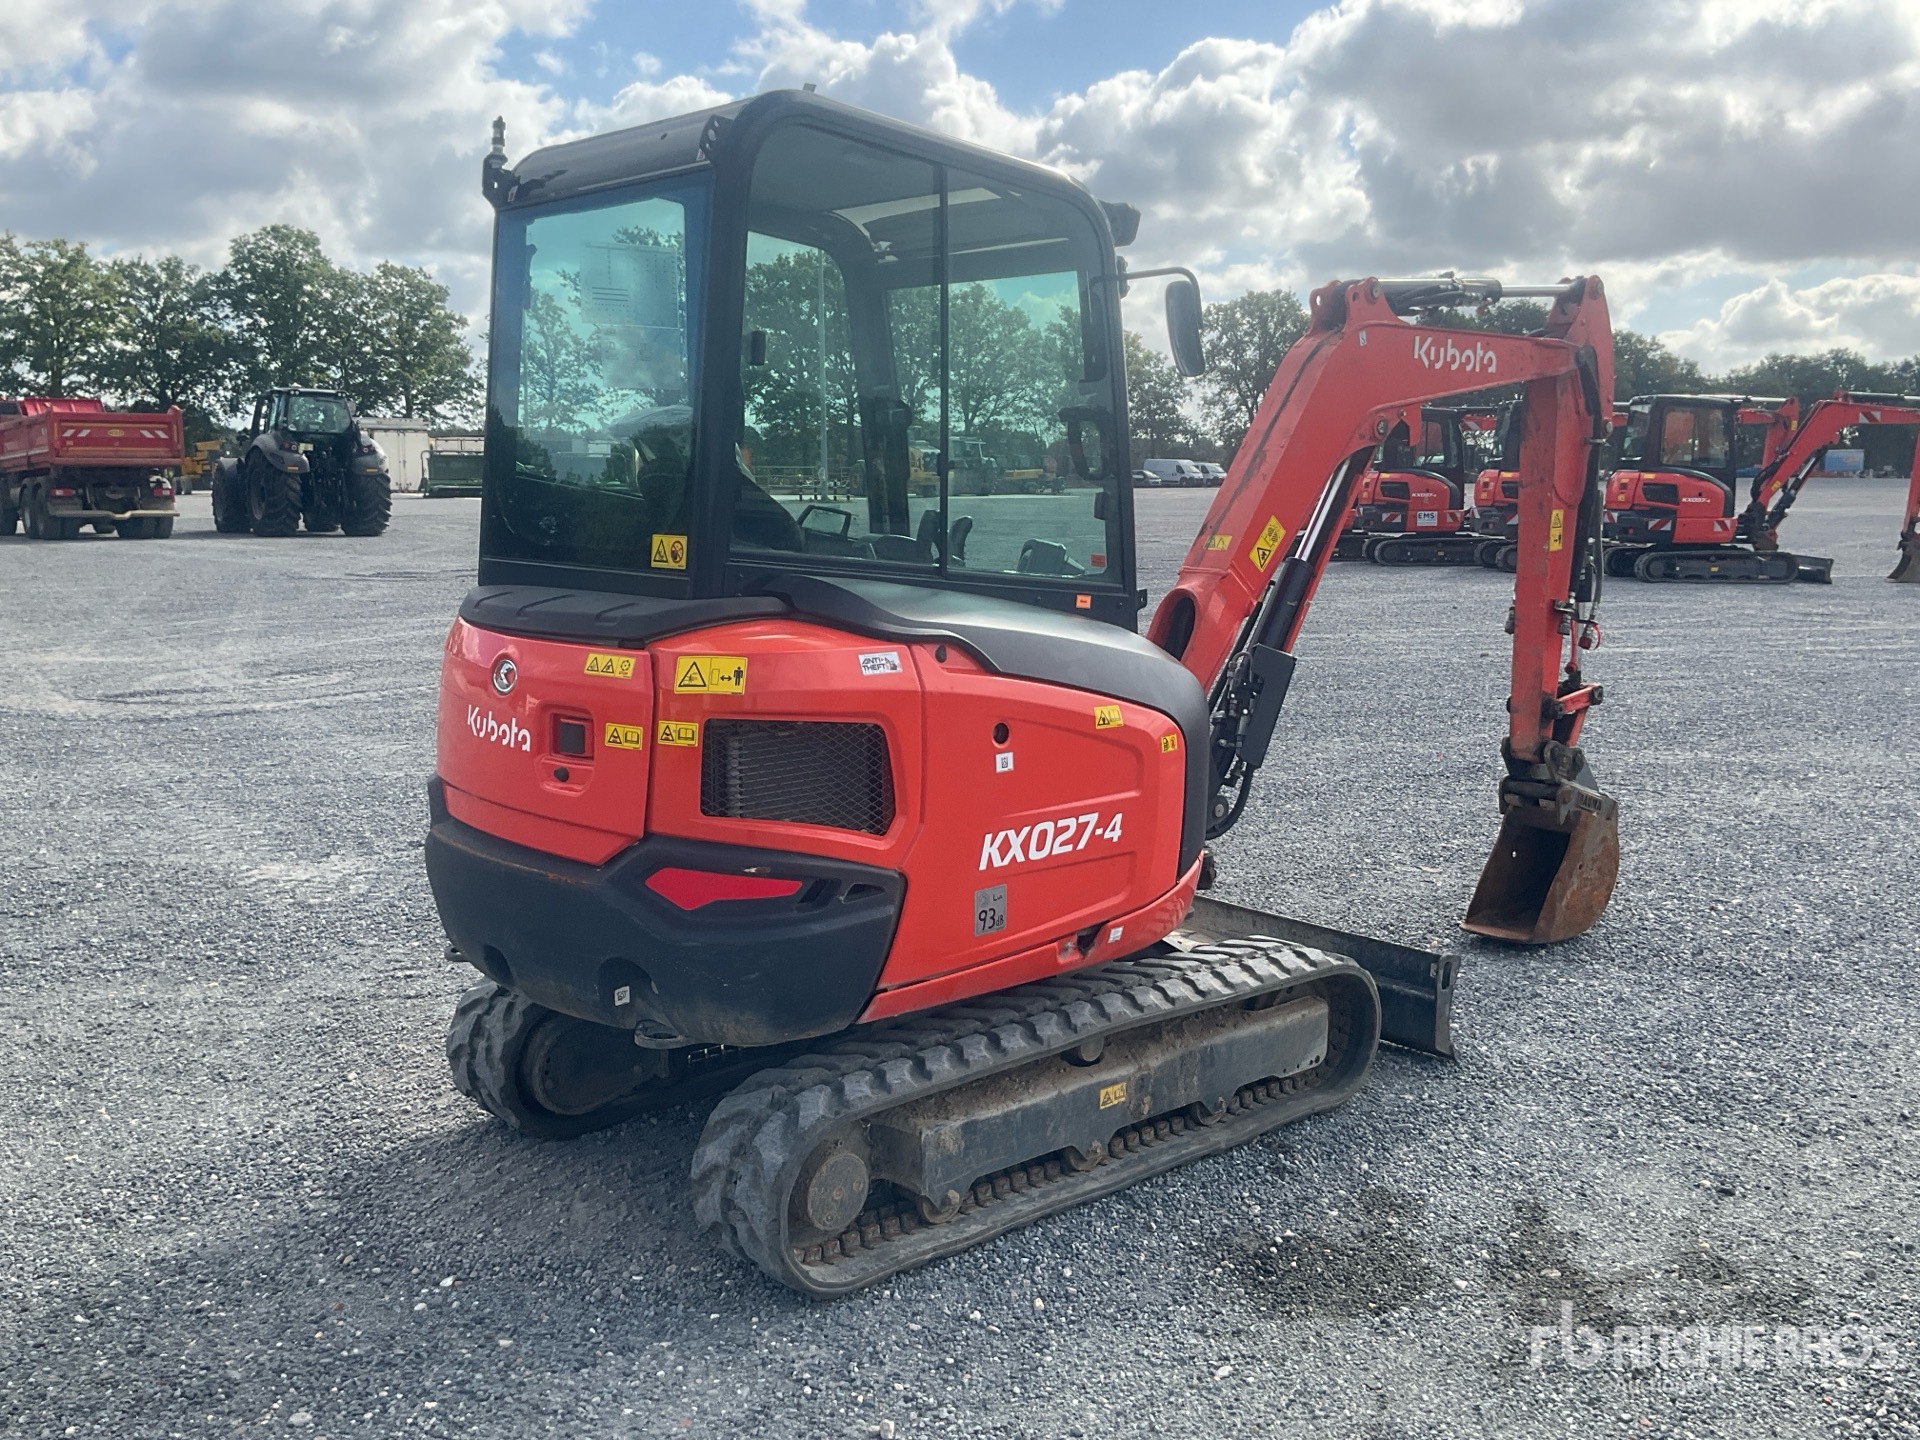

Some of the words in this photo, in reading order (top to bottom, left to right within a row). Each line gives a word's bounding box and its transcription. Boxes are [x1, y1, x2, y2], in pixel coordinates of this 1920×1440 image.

[1413, 335, 1497, 374] Kubota
[467, 704, 532, 752] Kubota
[978, 811, 1123, 871] KX027-4
